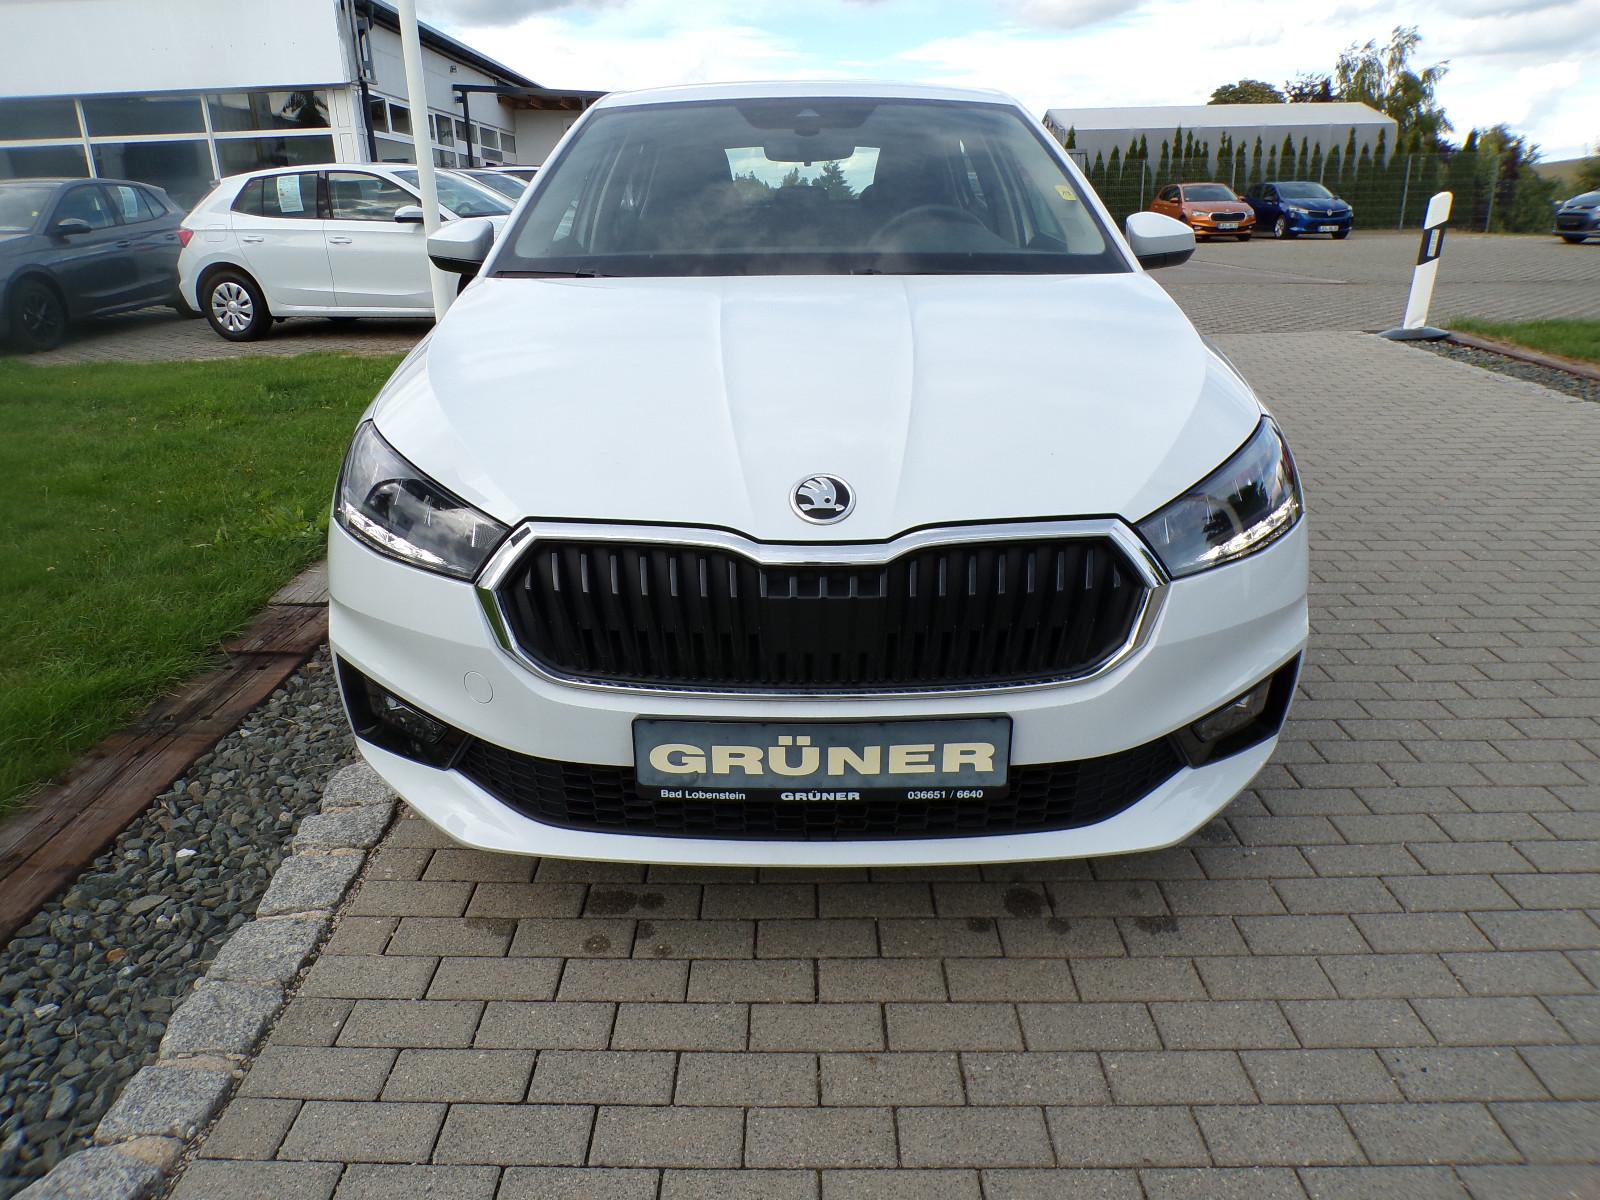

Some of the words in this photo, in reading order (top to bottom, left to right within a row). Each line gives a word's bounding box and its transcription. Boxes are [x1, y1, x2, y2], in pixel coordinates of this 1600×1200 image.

[649, 735, 996, 777] GRÜNER
[660, 789, 682, 799] Bad
[685, 790, 746, 801] Lobenstein
[780, 790, 860, 801] GRÜNER
[907, 790, 946, 800] 036651
[956, 789, 984, 799] 6640
